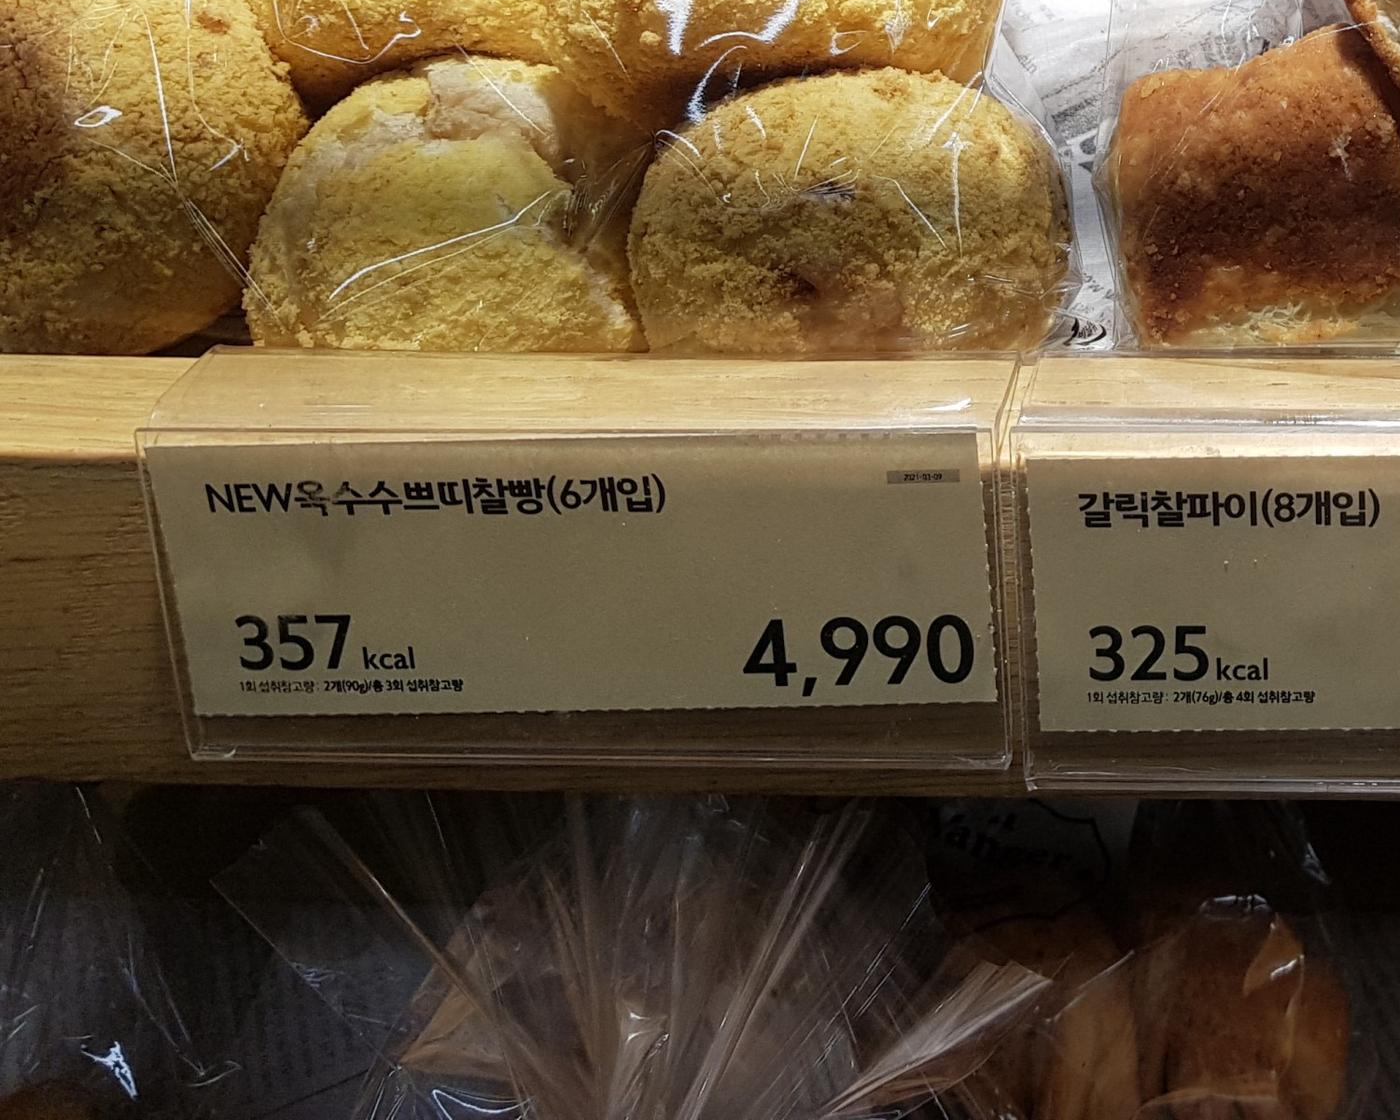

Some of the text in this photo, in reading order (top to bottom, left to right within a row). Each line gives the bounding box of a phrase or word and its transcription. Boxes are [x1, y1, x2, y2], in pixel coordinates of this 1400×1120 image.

[204, 473, 666, 518] NEW옥수수쁘띠찰빵(6개입)
[1077, 488, 1381, 528] 갈릭찰파이(8개입)
[235, 614, 416, 670] 357 kcal
[742, 614, 975, 697] 4,990
[1088, 625, 1269, 681] 325 kcal
